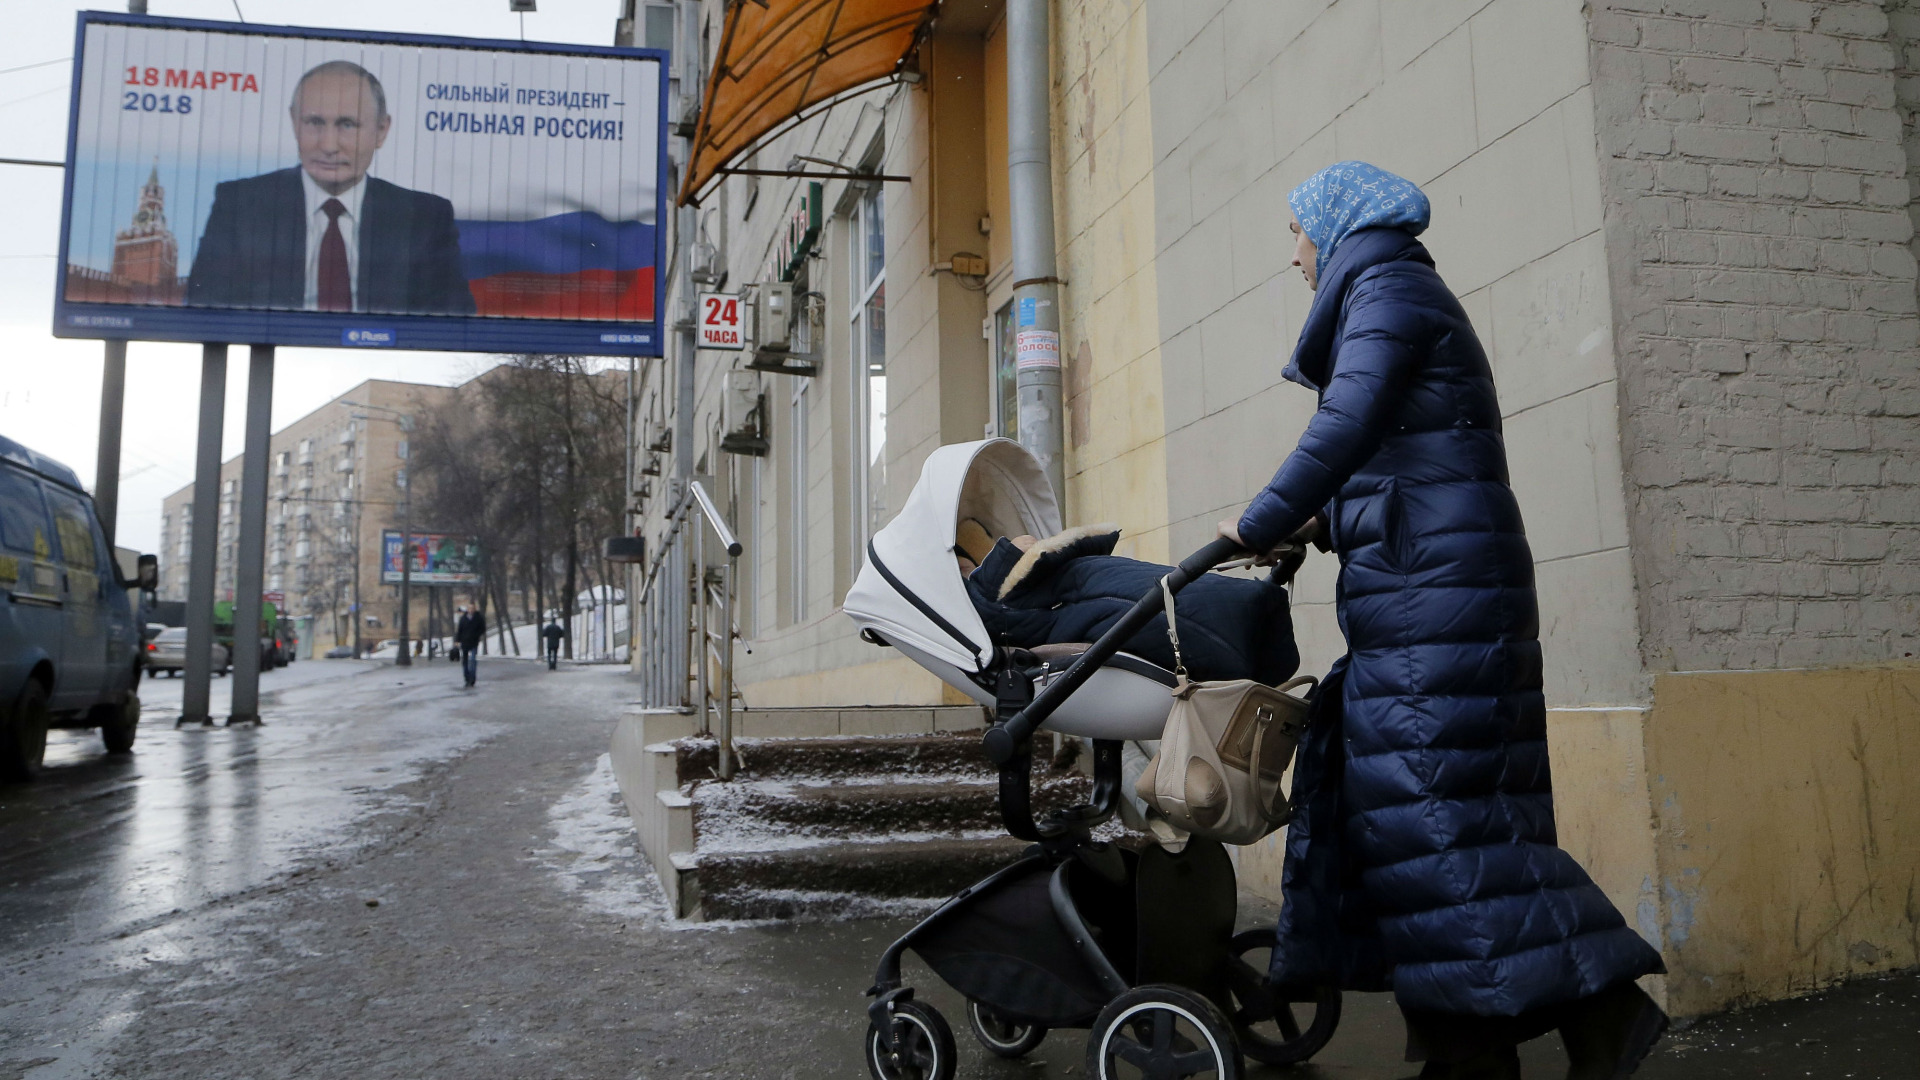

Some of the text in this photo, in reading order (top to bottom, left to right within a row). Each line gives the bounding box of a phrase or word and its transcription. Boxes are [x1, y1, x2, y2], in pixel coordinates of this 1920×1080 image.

[125, 66, 259, 93] 18 МАРТА
[123, 91, 192, 114] 2018
[426, 82, 509, 104] СИЛЬНЫЙ
[516, 88, 610, 111] ПРЕЗИДЕНТ
[425, 111, 624, 141] СИЛЬНАЯ РОССИЯ!
[705, 297, 738, 326] 24
[704, 330, 738, 344] ЧАСА
